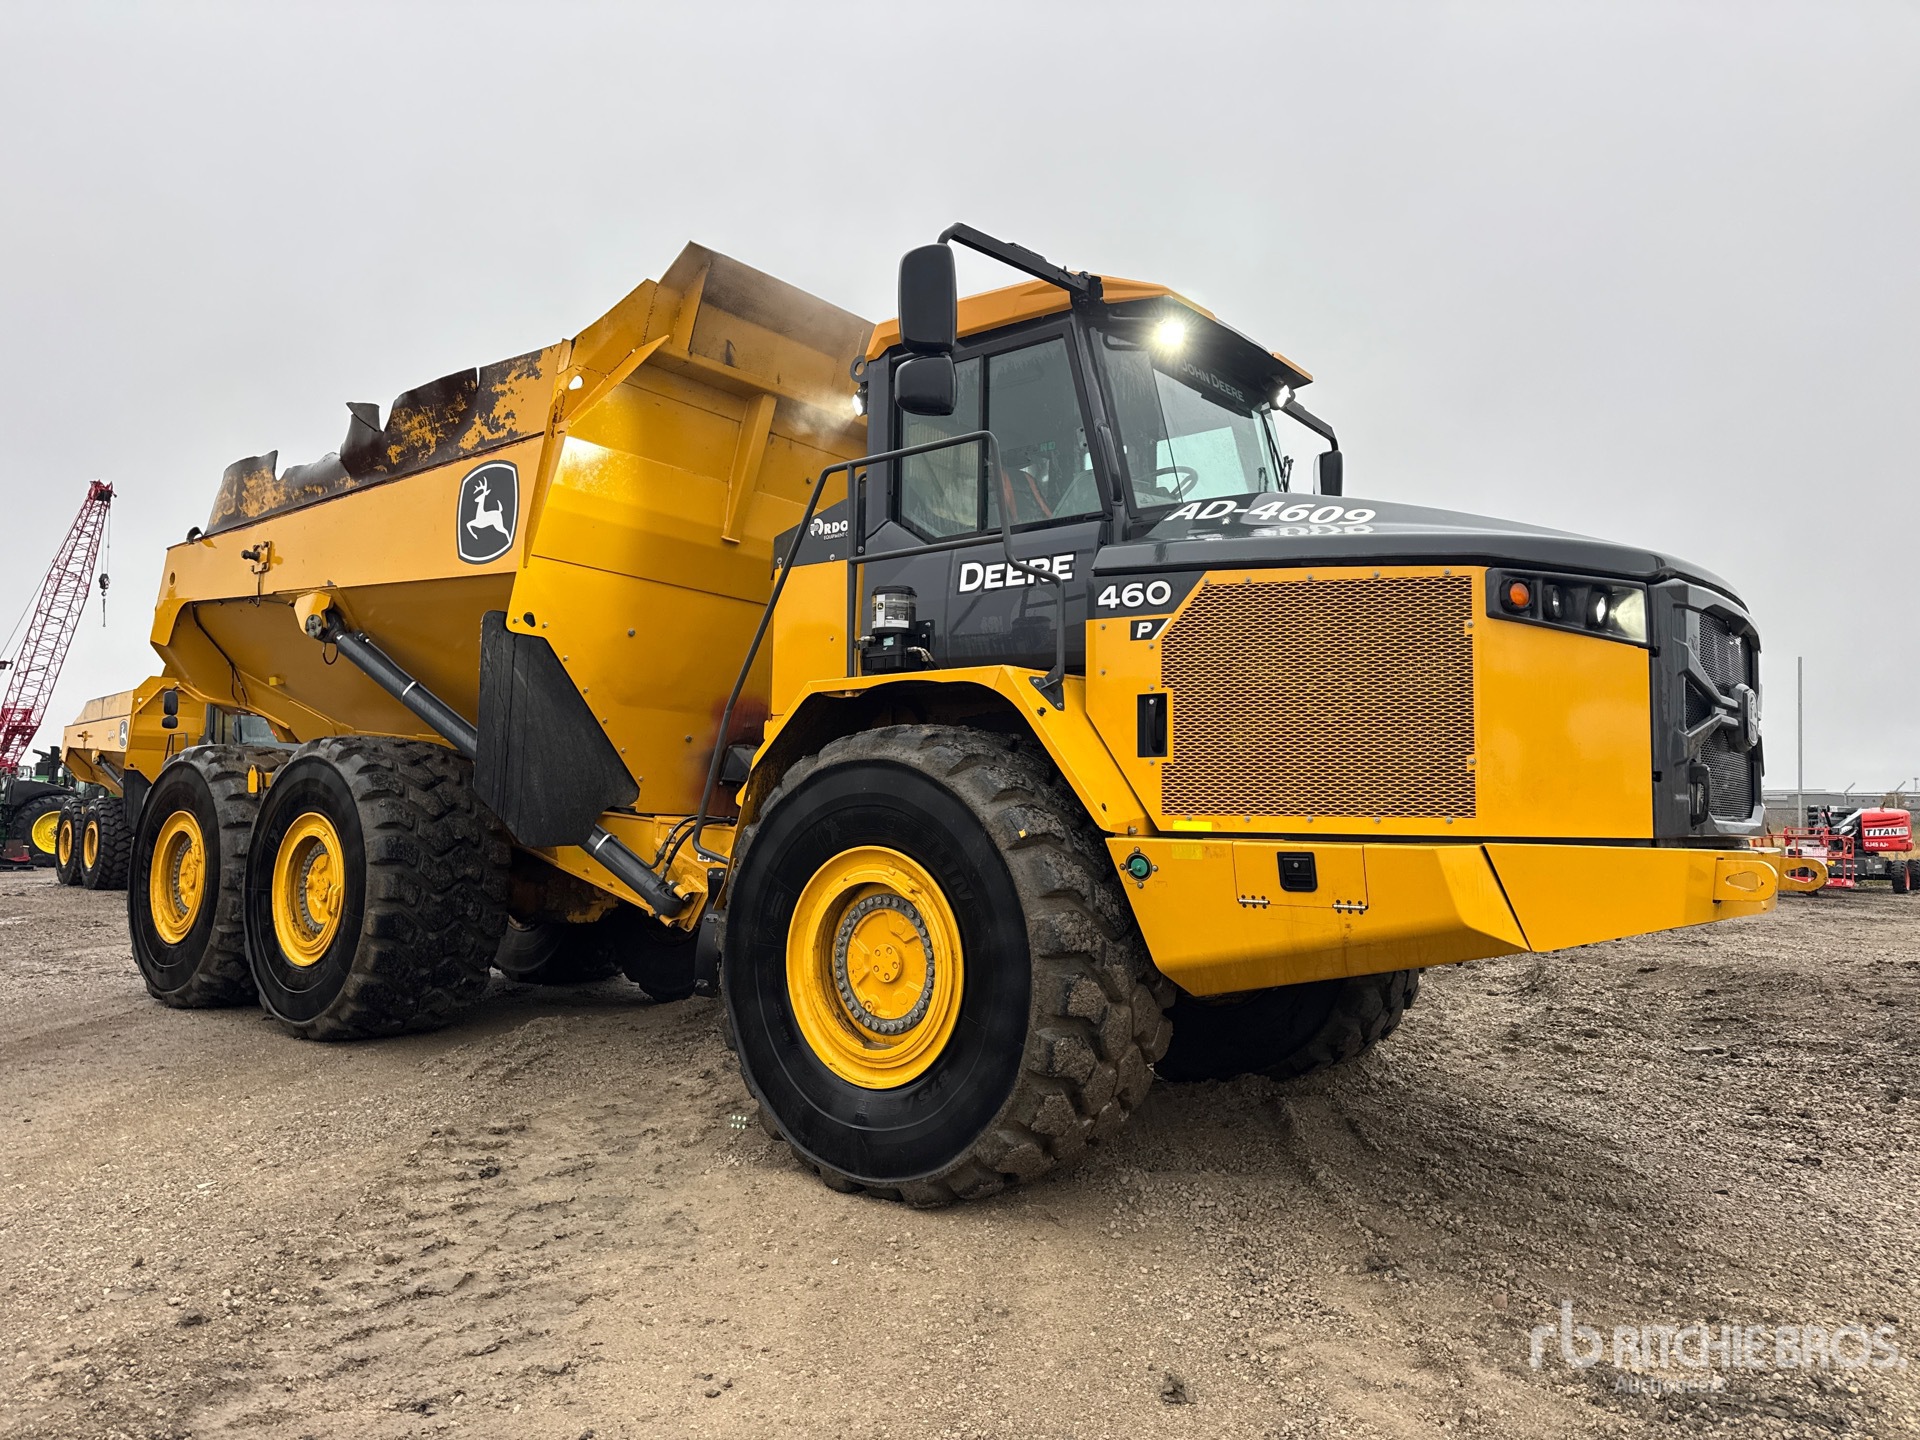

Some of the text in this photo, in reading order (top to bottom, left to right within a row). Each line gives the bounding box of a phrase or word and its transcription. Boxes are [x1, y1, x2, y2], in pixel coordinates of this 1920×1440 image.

[1182, 359, 1245, 402] JOHN DEERE
[1164, 500, 1377, 525] AD-4609
[958, 553, 1075, 593] DEERE
[1097, 580, 1172, 609] 460
[1865, 828, 1898, 836] TITAN
